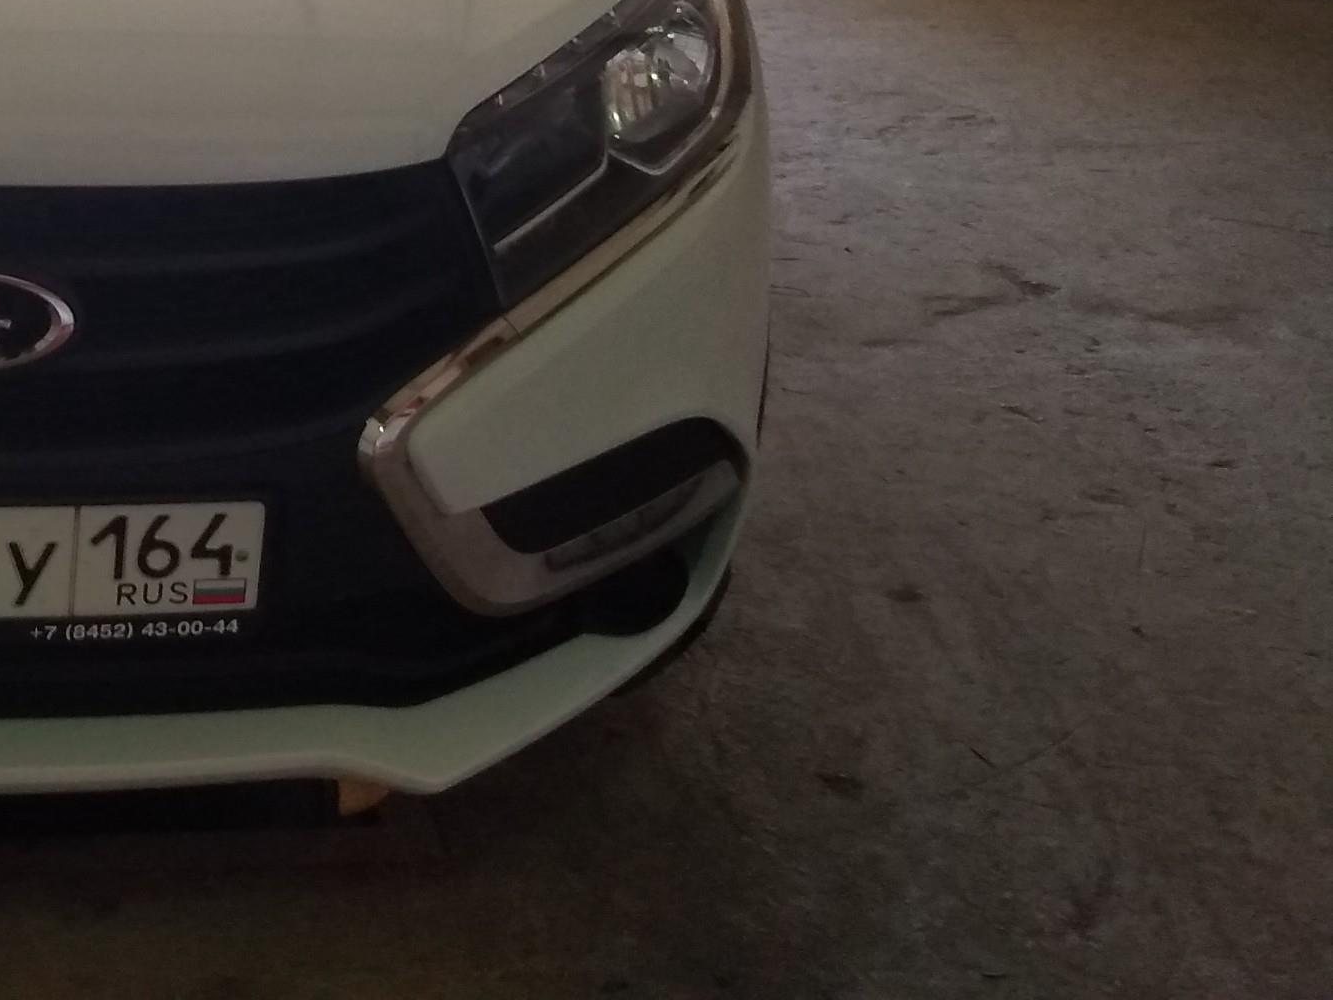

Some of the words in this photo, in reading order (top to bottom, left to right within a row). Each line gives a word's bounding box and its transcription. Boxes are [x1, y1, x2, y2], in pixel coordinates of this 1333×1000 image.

[89, 512, 234, 580] 164
[115, 582, 189, 607] RUS
[29, 625, 58, 641] +7
[65, 622, 135, 641] (8452)
[140, 618, 240, 638] 43-00-44
